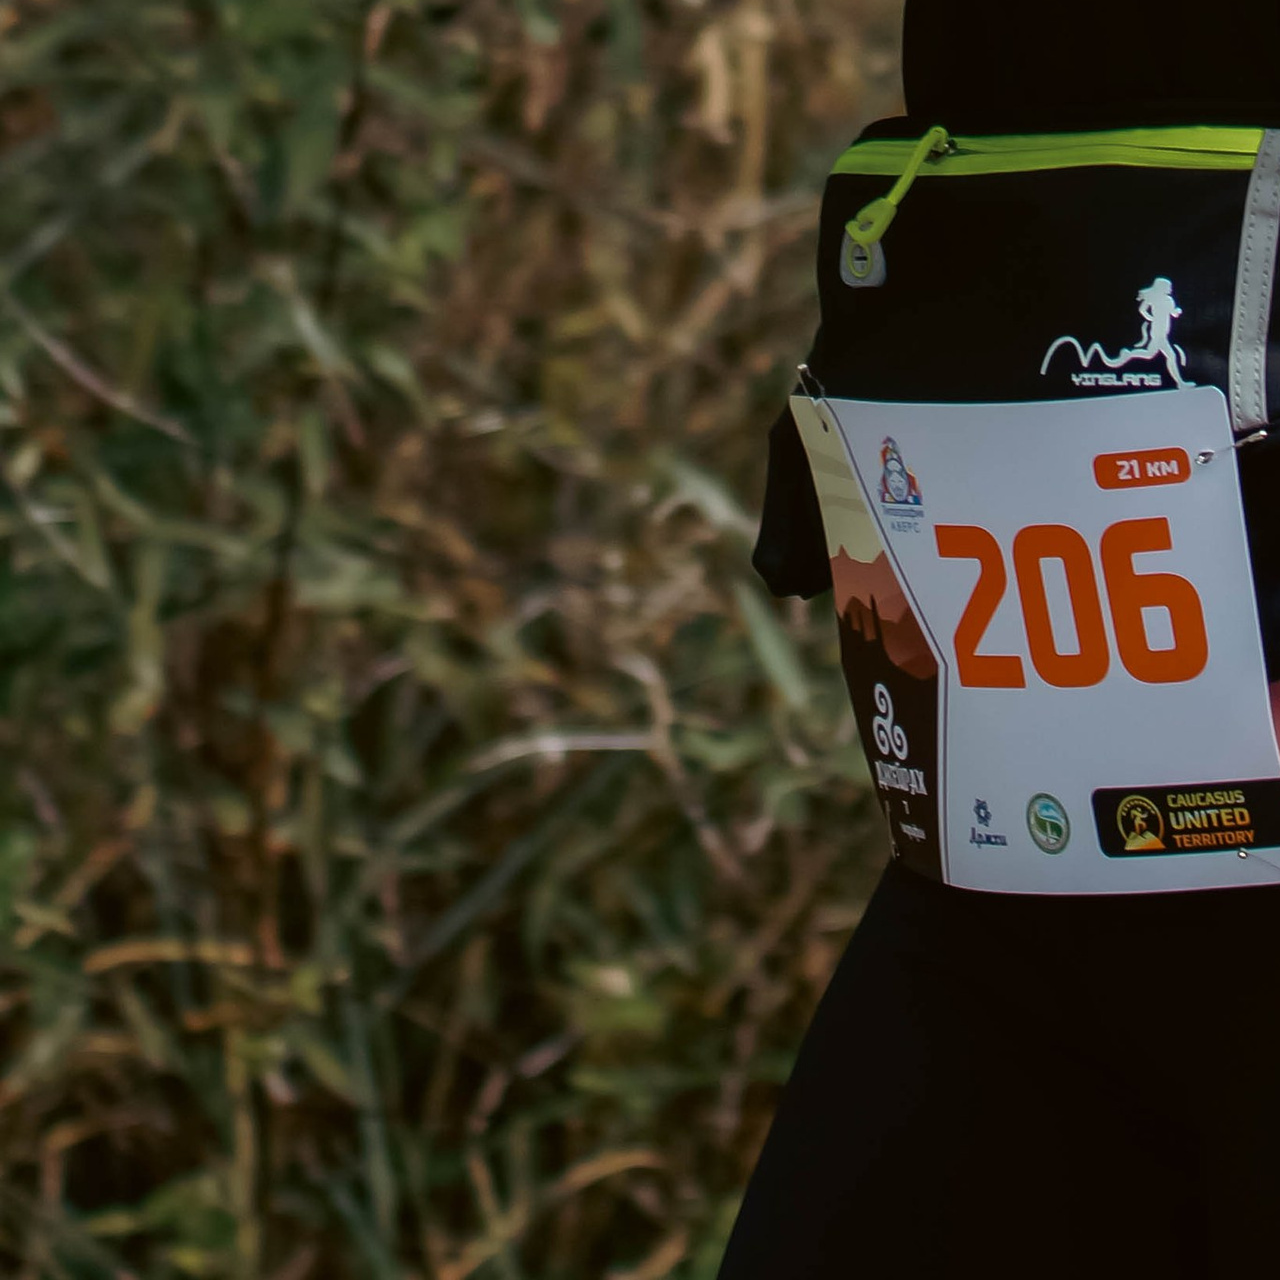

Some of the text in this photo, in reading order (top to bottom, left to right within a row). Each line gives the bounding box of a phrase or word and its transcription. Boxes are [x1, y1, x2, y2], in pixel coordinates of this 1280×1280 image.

[1116, 459, 1141, 480] 21
[933, 516, 1209, 688] 206
[1166, 789, 1246, 808] CAUCASUS
[1168, 806, 1251, 830] UNITED
[1171, 829, 1255, 848] TERRITORY
